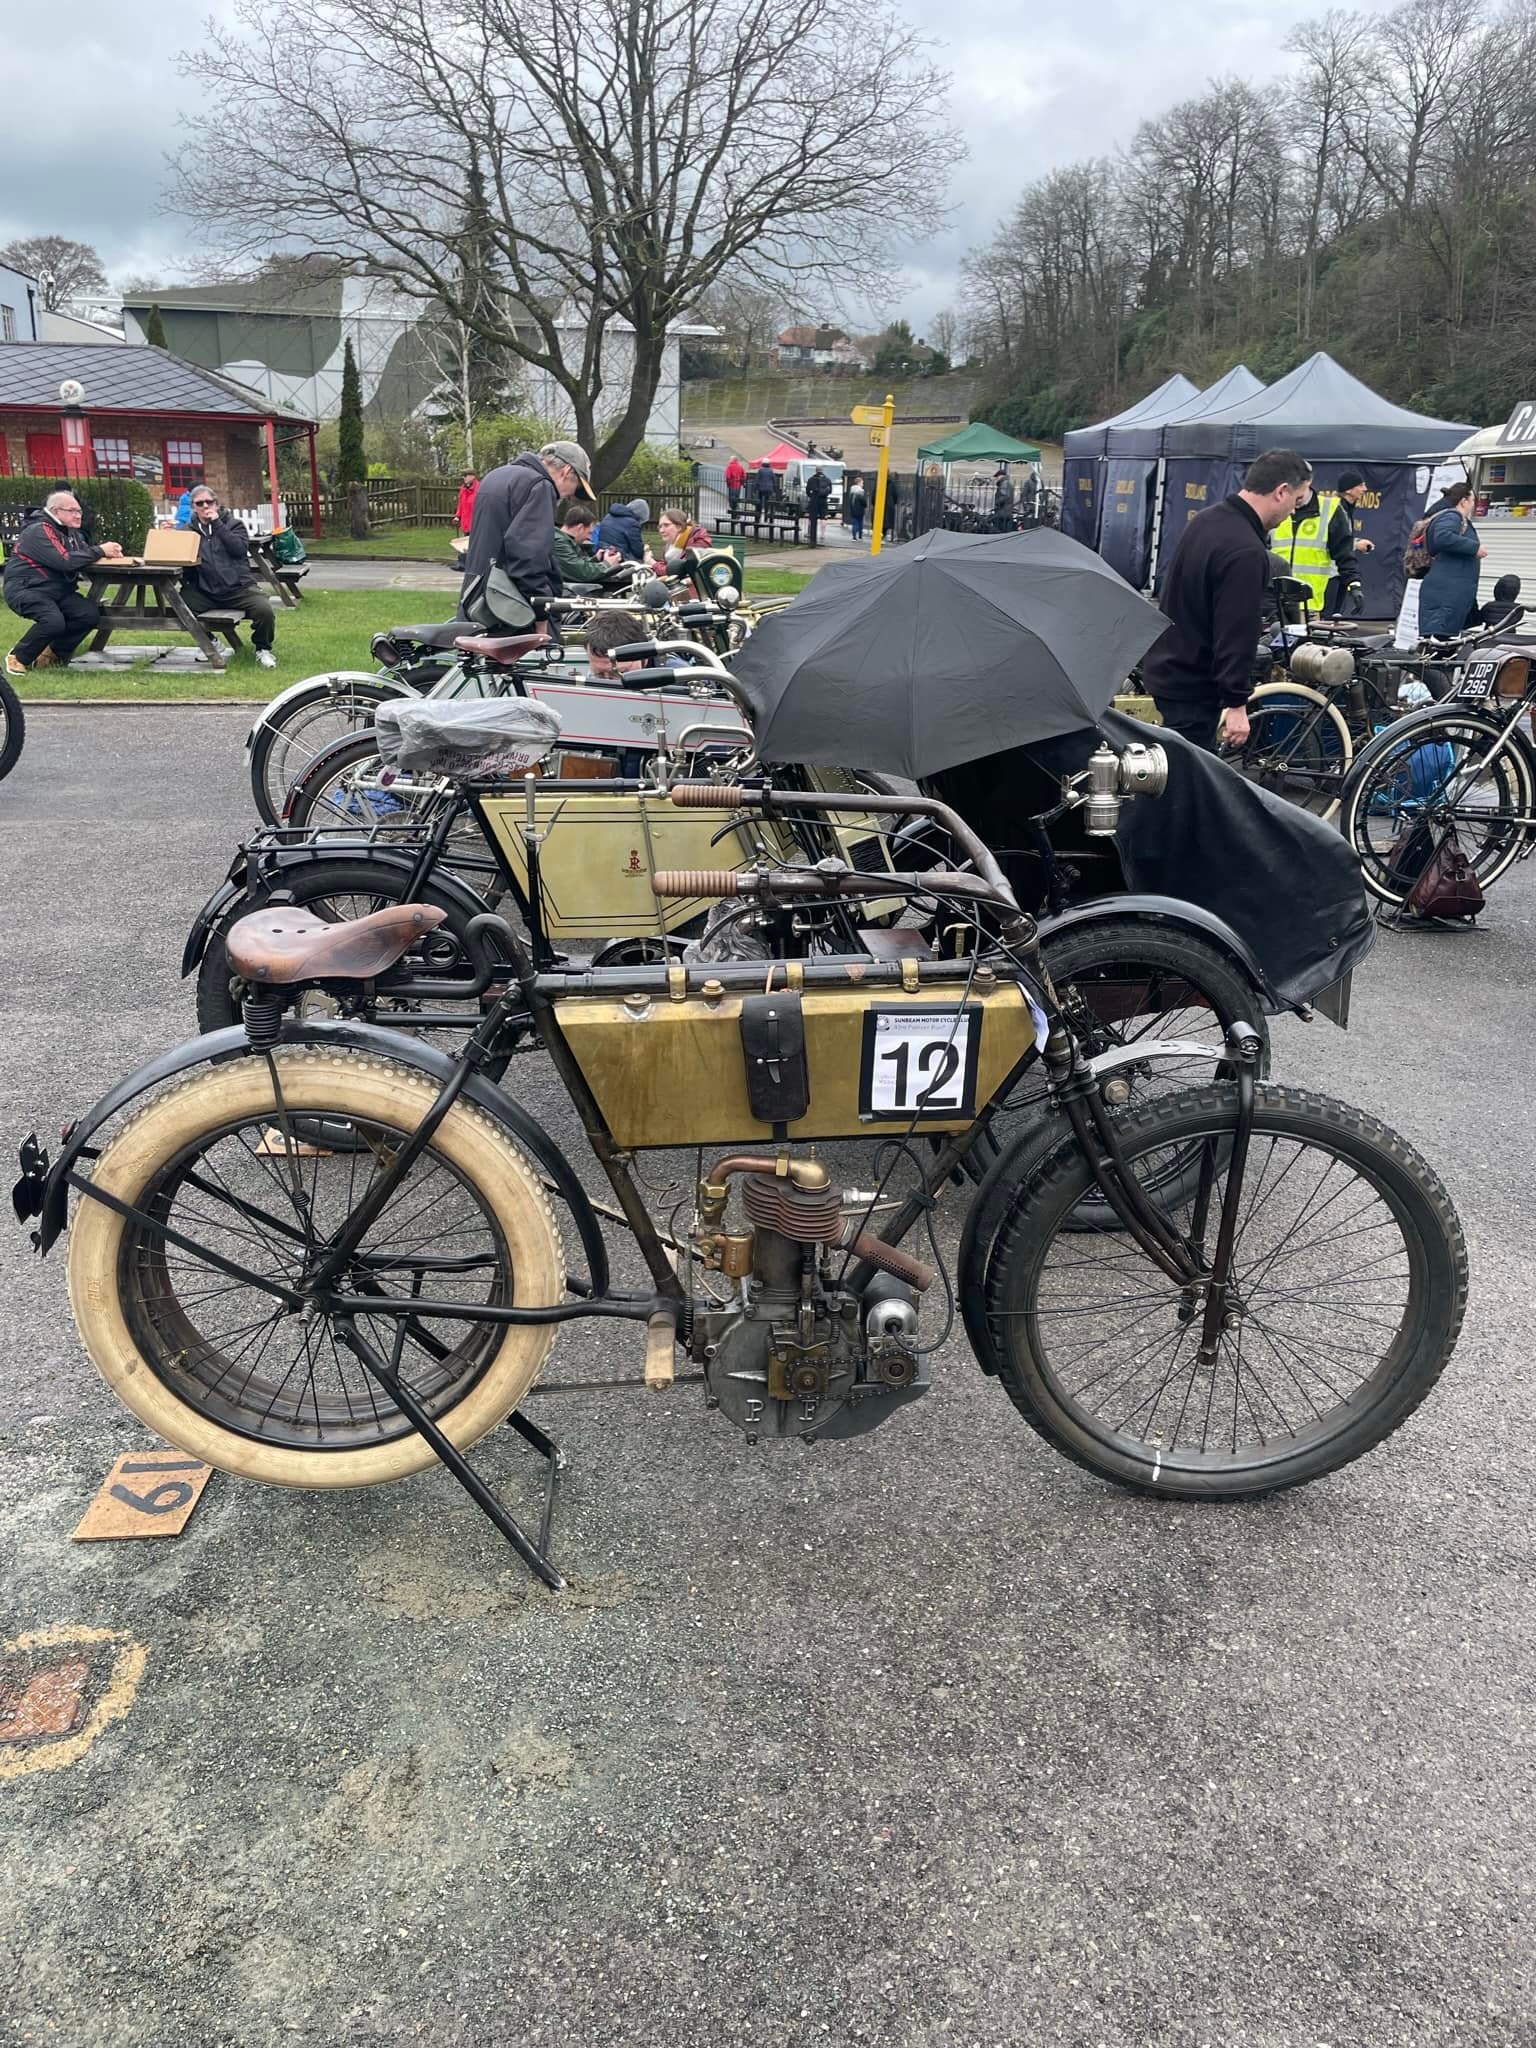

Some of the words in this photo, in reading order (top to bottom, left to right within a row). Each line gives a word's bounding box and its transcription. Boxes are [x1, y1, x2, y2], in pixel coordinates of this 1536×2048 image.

[1469, 663, 1493, 678] JDP
[1463, 679, 1488, 694] 296
[881, 1041, 960, 1107] 12
[745, 1399, 764, 1421] P
